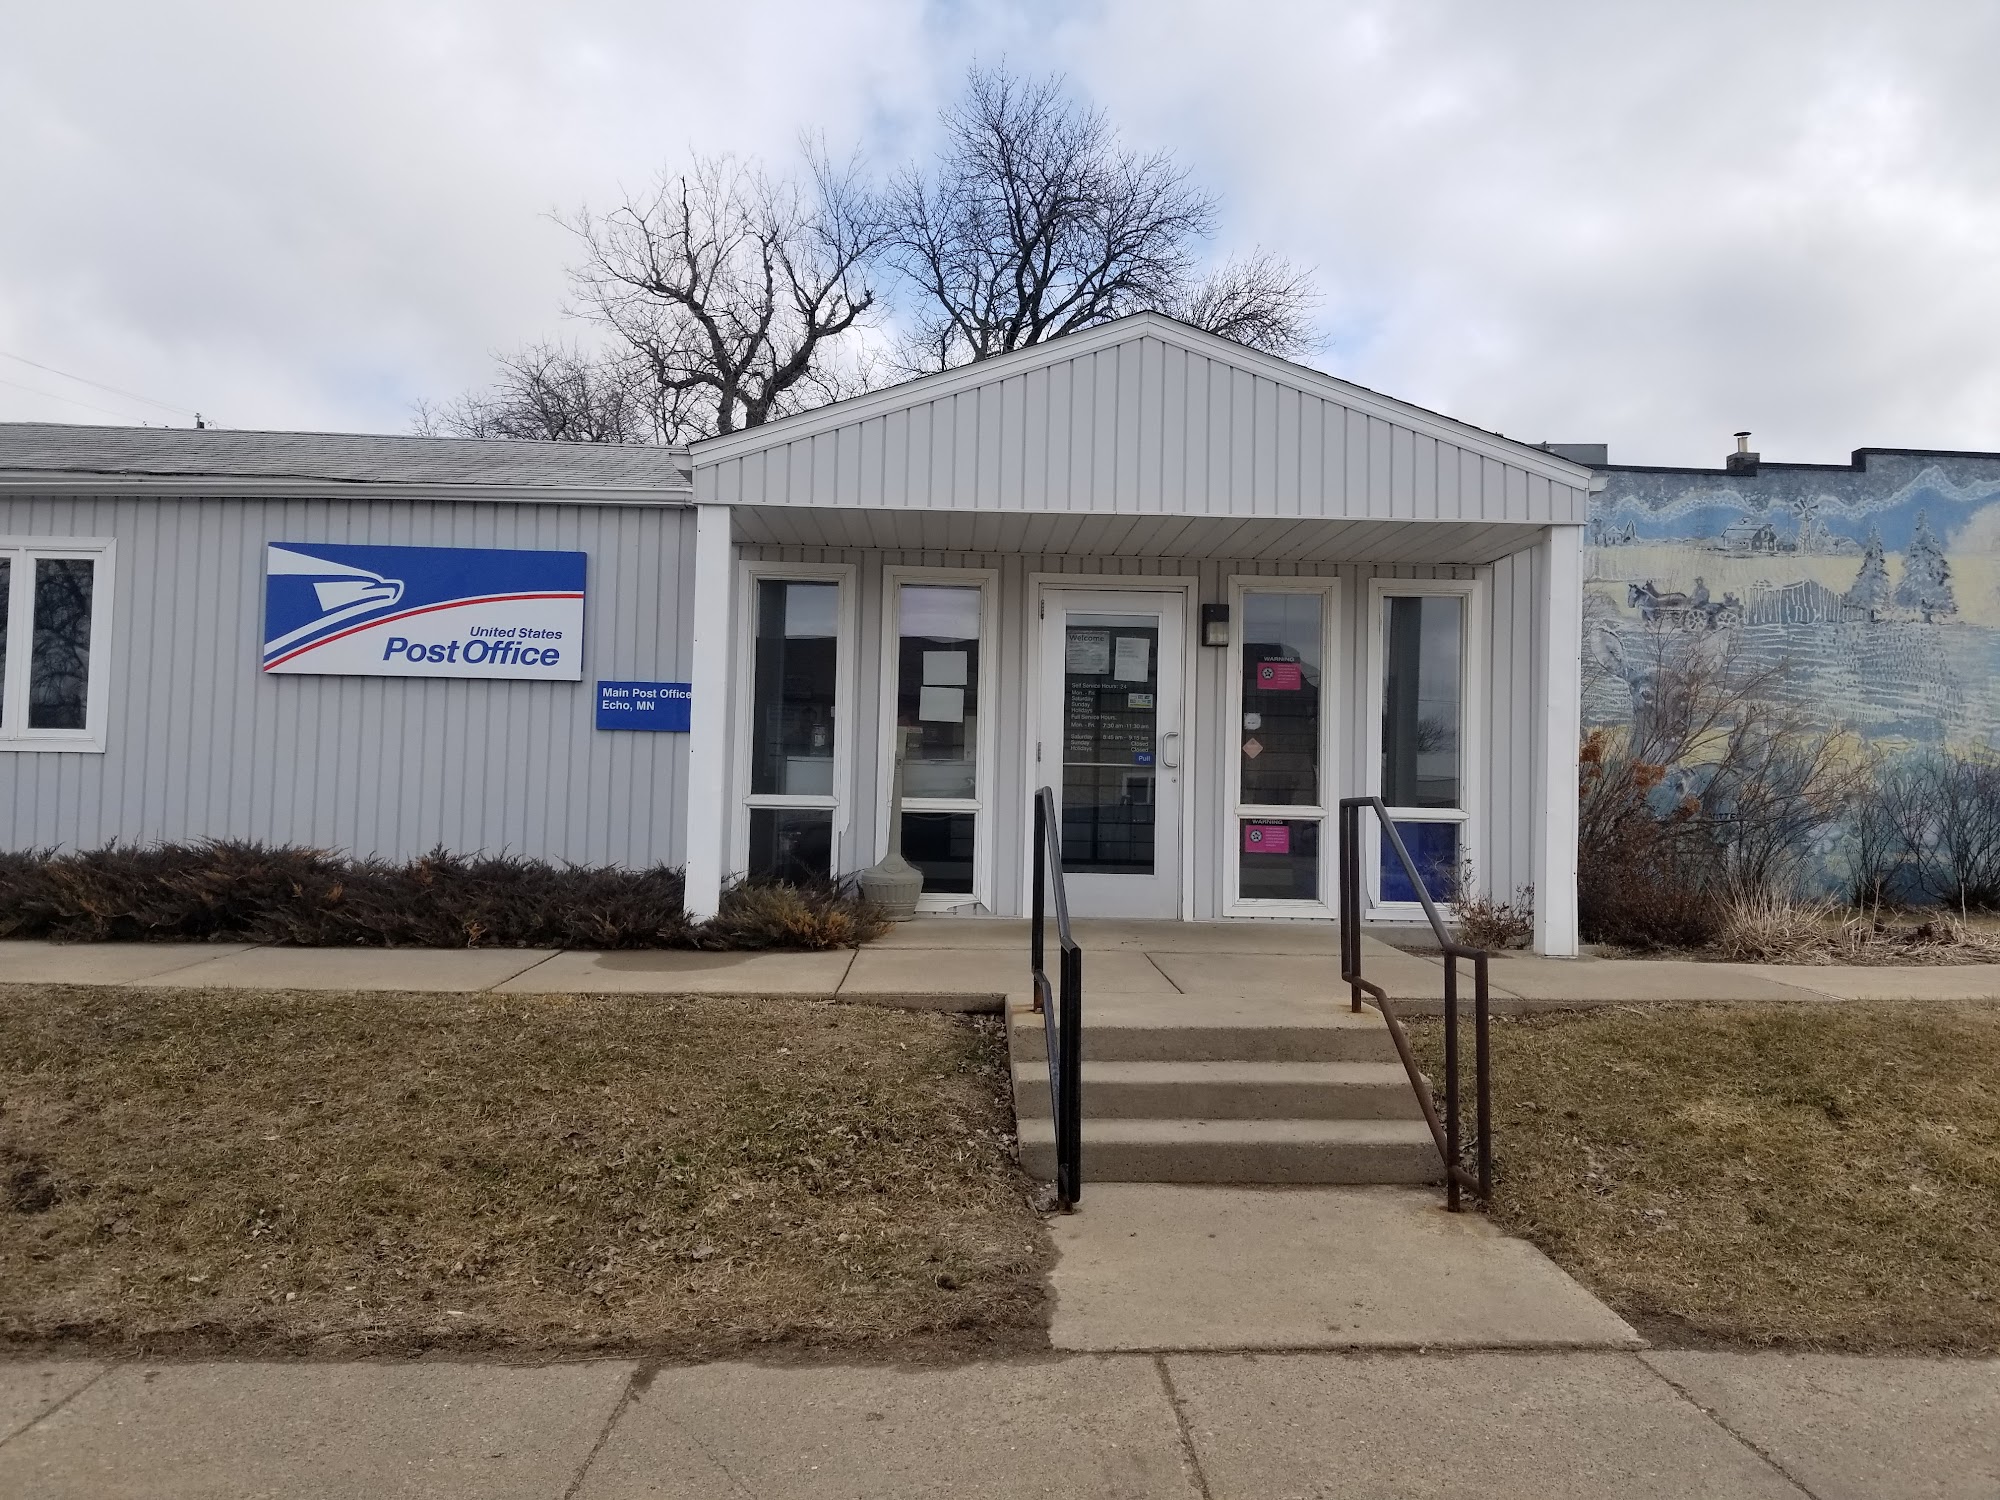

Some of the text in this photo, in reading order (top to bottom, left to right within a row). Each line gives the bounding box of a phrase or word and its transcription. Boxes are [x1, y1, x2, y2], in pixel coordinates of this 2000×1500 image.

[469, 626, 563, 640] United States
[1069, 634, 1105, 642] Welcome
[383, 637, 560, 667] Post Office
[602, 687, 692, 699] Main Post Office
[602, 700, 655, 712] Echo, MN
